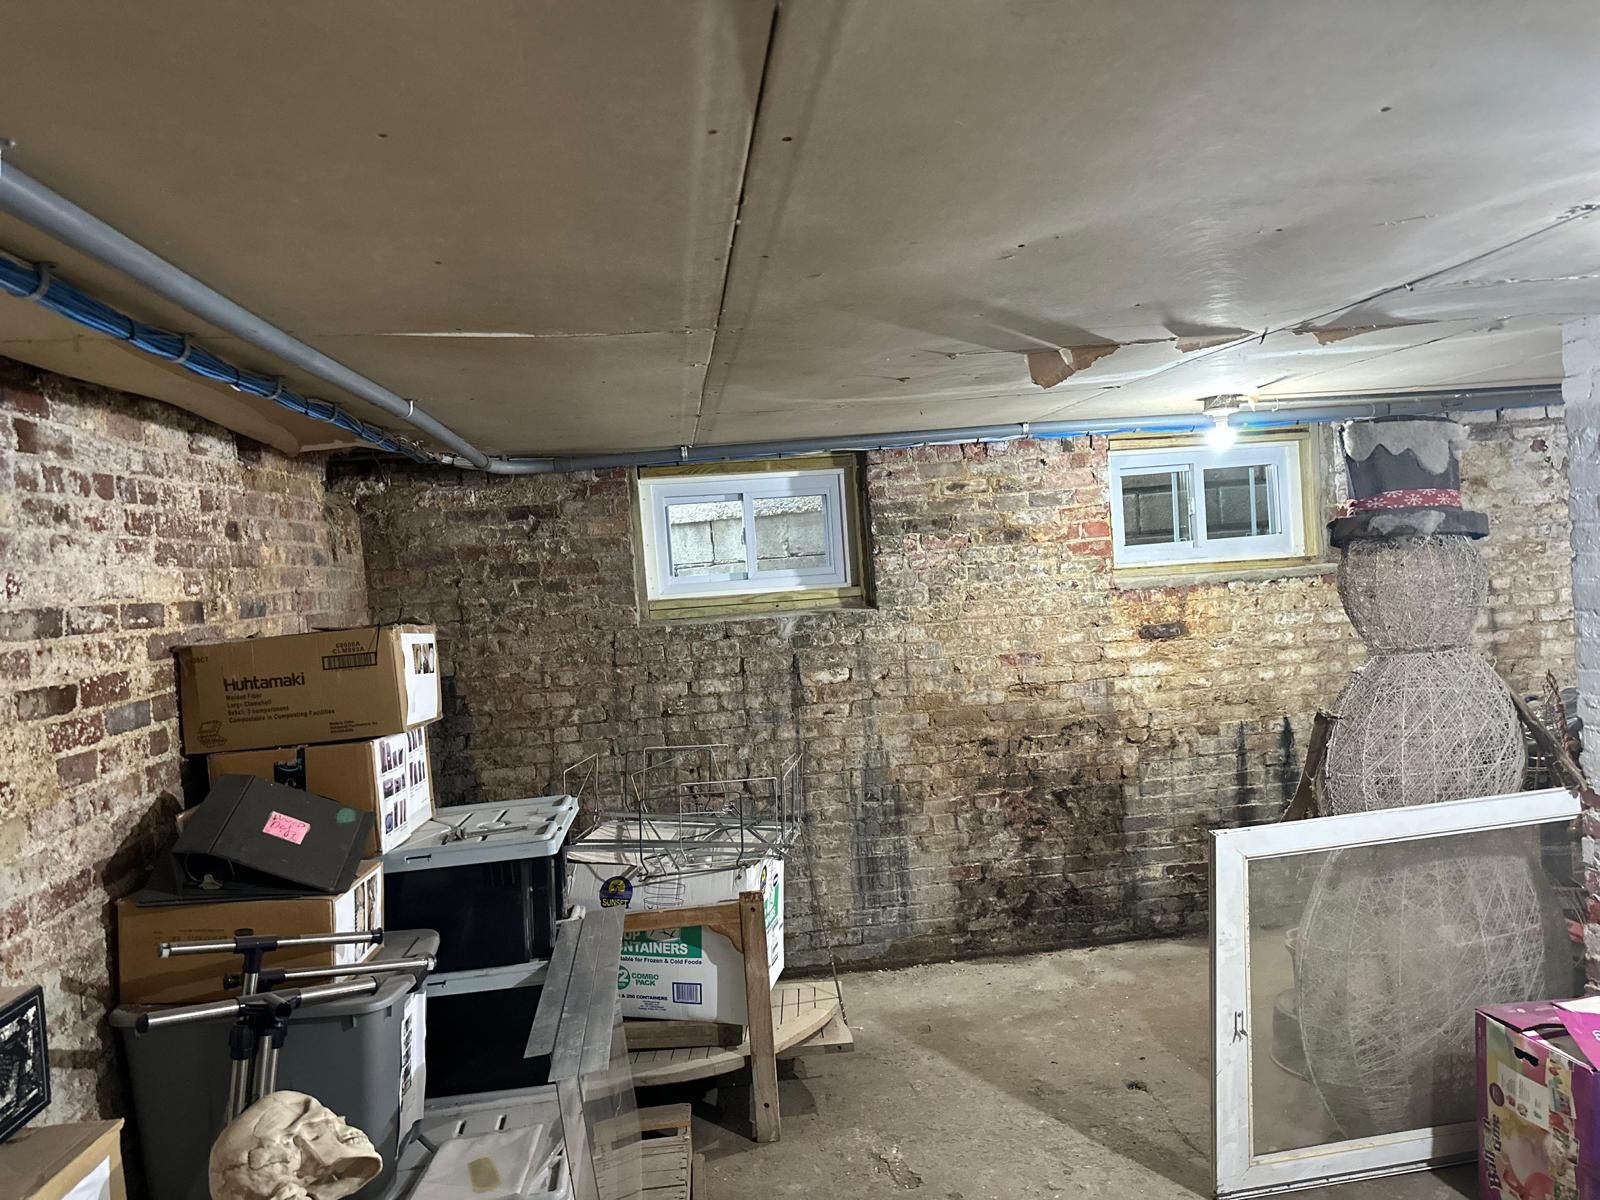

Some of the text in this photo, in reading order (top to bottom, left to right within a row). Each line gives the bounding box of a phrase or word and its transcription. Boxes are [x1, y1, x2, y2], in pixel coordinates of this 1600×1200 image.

[224, 672, 305, 692] Huhtamaki
[273, 711, 308, 720] Composting
[602, 898, 629, 907] SUNSET
[620, 941, 688, 955] NTAINERS
